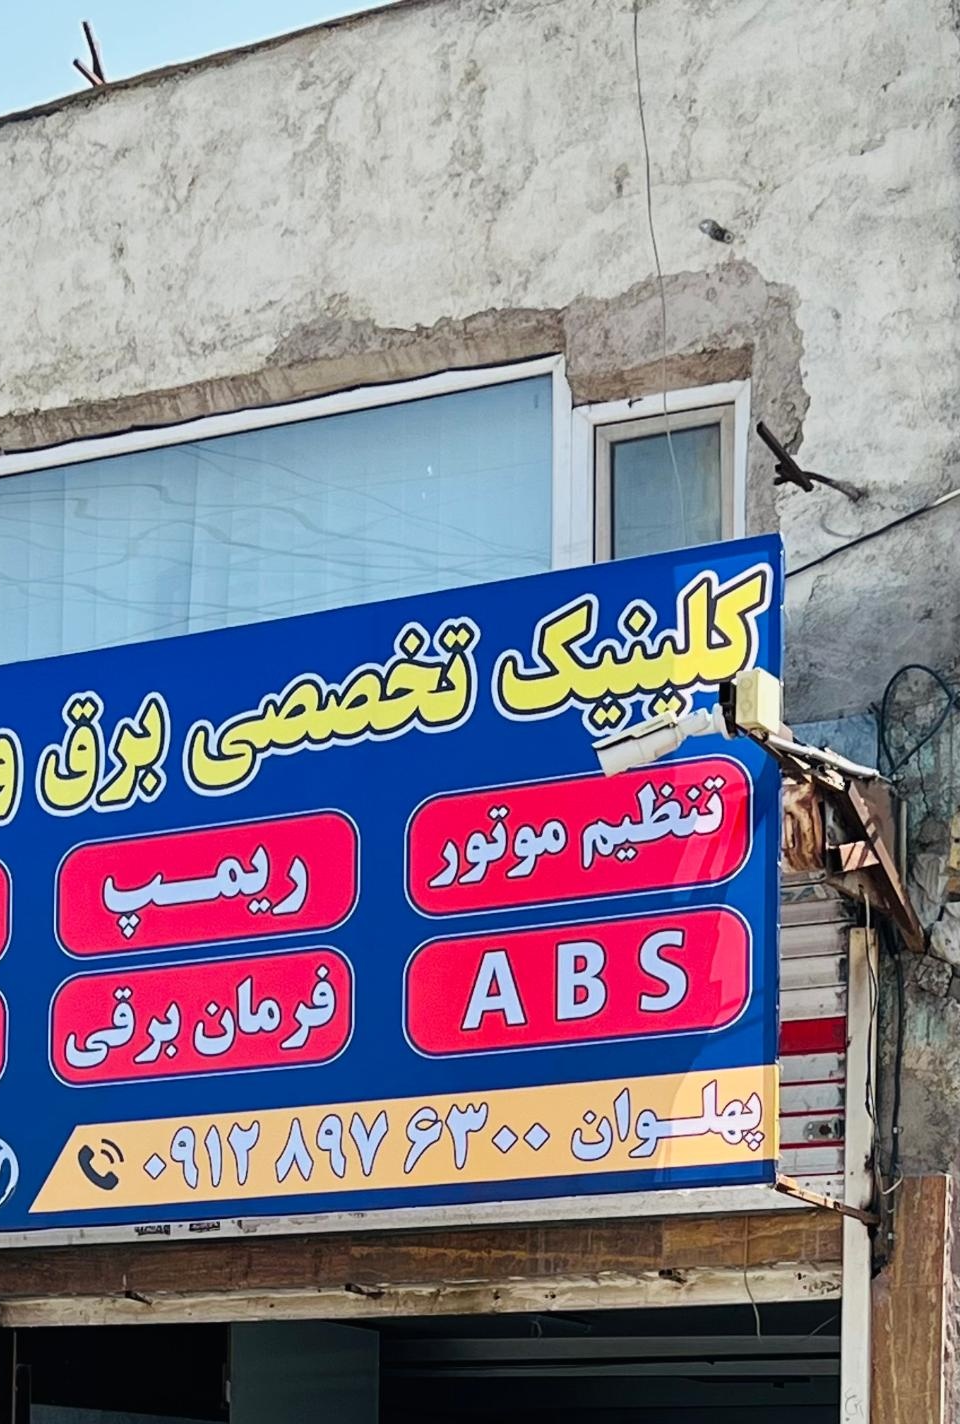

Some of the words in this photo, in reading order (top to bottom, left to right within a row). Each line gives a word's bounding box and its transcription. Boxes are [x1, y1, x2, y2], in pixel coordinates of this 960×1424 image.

[494, 564, 773, 732] کلینیک
[37, 690, 170, 816] برق
[184, 618, 478, 797] تخصصی
[428, 806, 567, 889] موتور
[581, 774, 728, 869] تنظیم
[102, 845, 309, 938] ریمپ
[64, 985, 182, 1066] برقی
[192, 965, 338, 1053] فرمان
[142, 1119, 260, 1190] ۰۹۱۲
[275, 1109, 389, 1182] ۸۹۷
[403, 1101, 551, 1175] ۶۳۰۰
[570, 1079, 766, 1165] پهلوان
